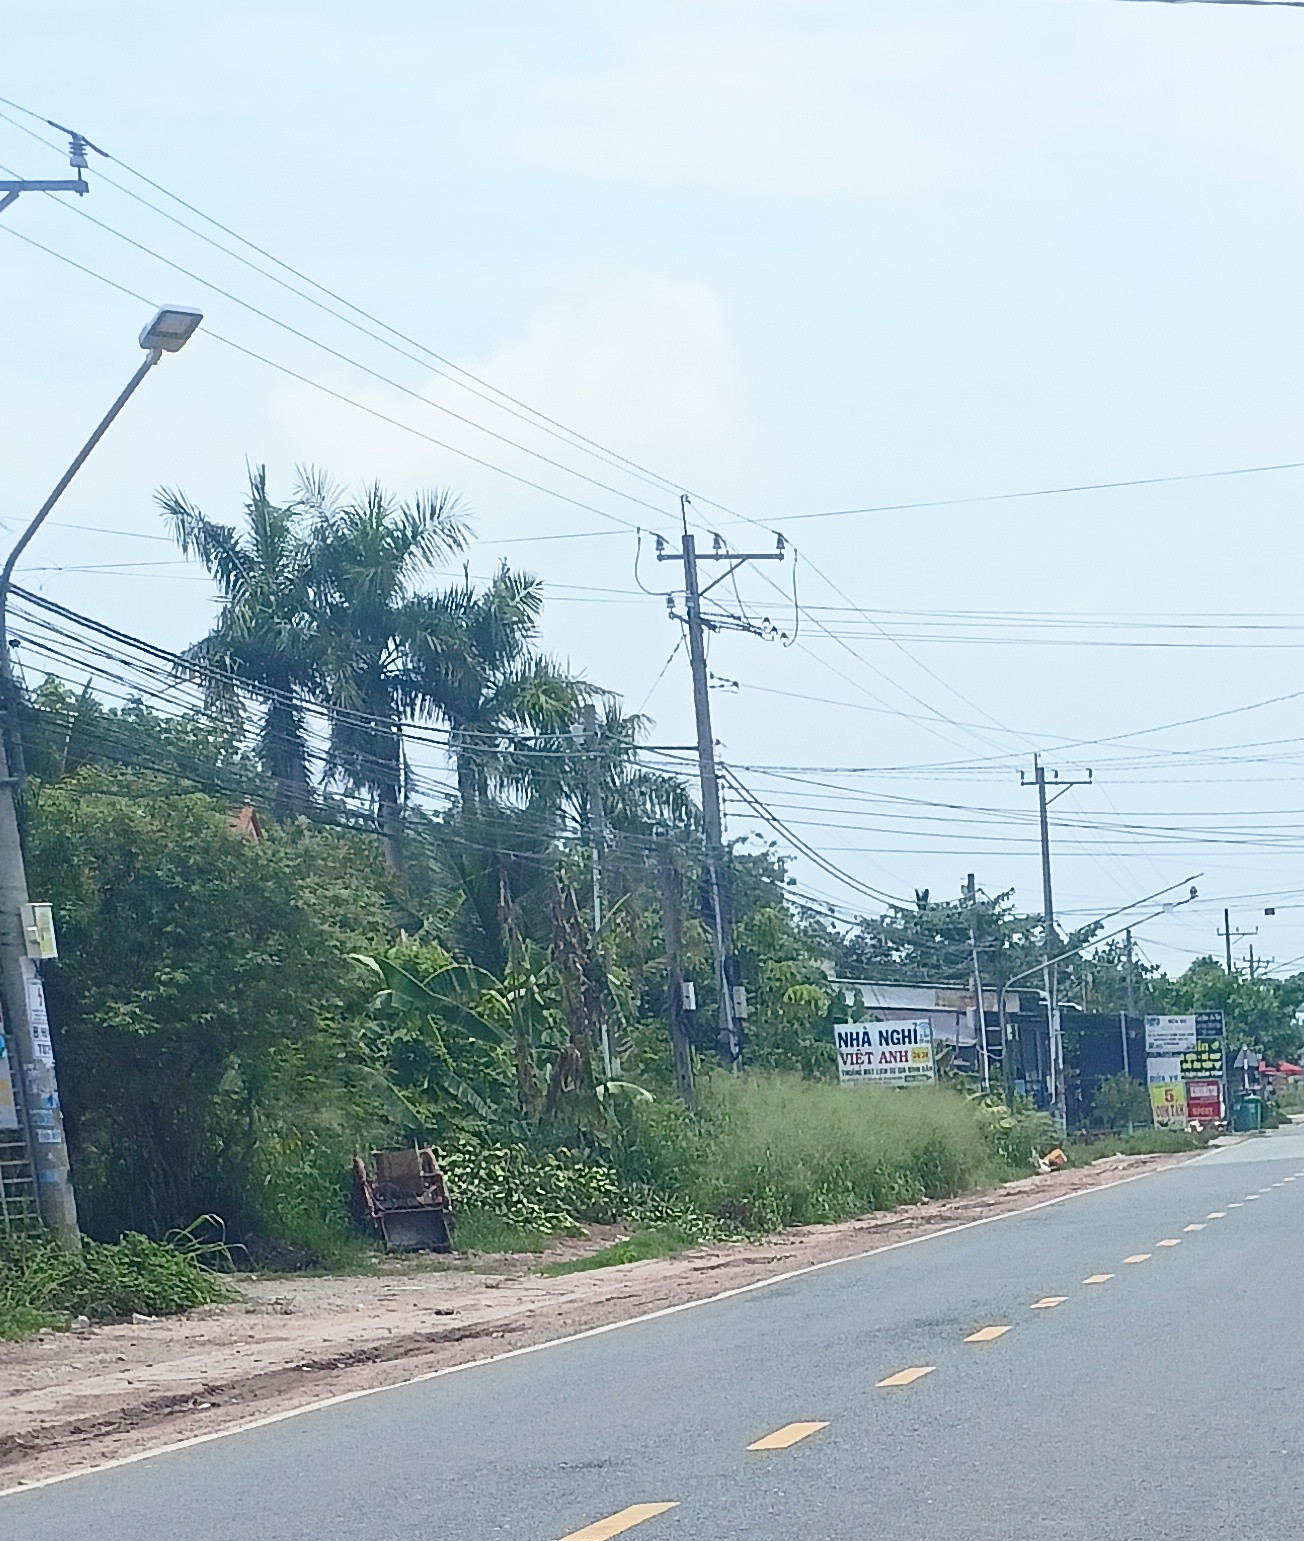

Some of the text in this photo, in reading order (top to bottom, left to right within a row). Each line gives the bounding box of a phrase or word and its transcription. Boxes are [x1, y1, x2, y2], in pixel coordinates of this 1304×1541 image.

[838, 1026, 872, 1048] NHÀ
[878, 1022, 918, 1046] NGHỈ
[840, 1049, 874, 1068] VIỆT
[879, 1050, 909, 1064] ANH
